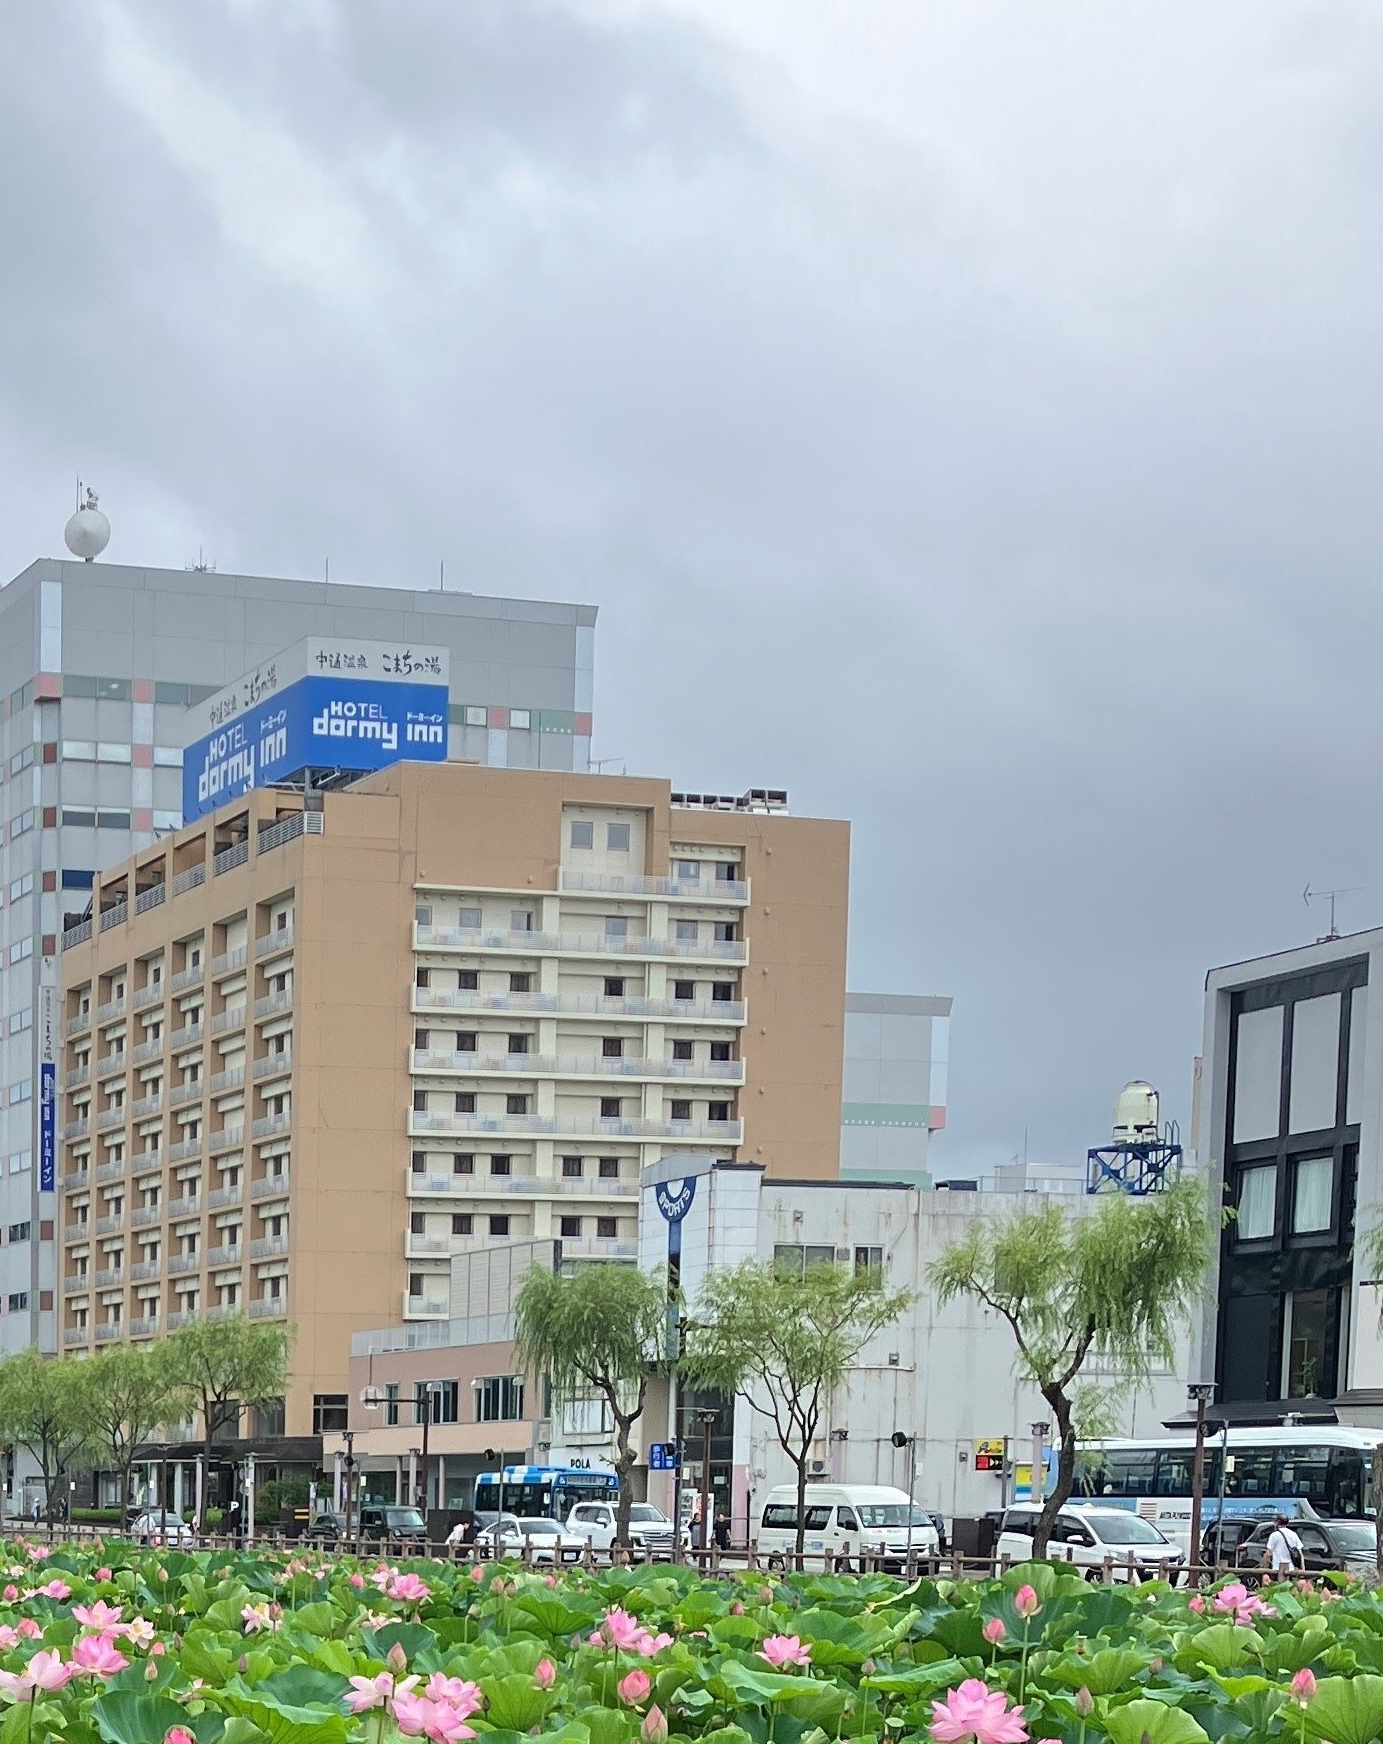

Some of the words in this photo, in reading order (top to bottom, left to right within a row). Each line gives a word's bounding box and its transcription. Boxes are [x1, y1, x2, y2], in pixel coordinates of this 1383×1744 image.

[382, 649, 442, 676] こまちの湯
[330, 700, 388, 719] HOTEL
[406, 711, 443, 723] ドーミーイン
[312, 707, 398, 750] dormy
[406, 723, 443, 743] inn
[209, 722, 248, 764] HOTEL
[198, 744, 255, 803] dormy
[260, 726, 287, 768] inn
[658, 1187, 691, 1217] SPORTS
[570, 1458, 591, 1469] POLA
